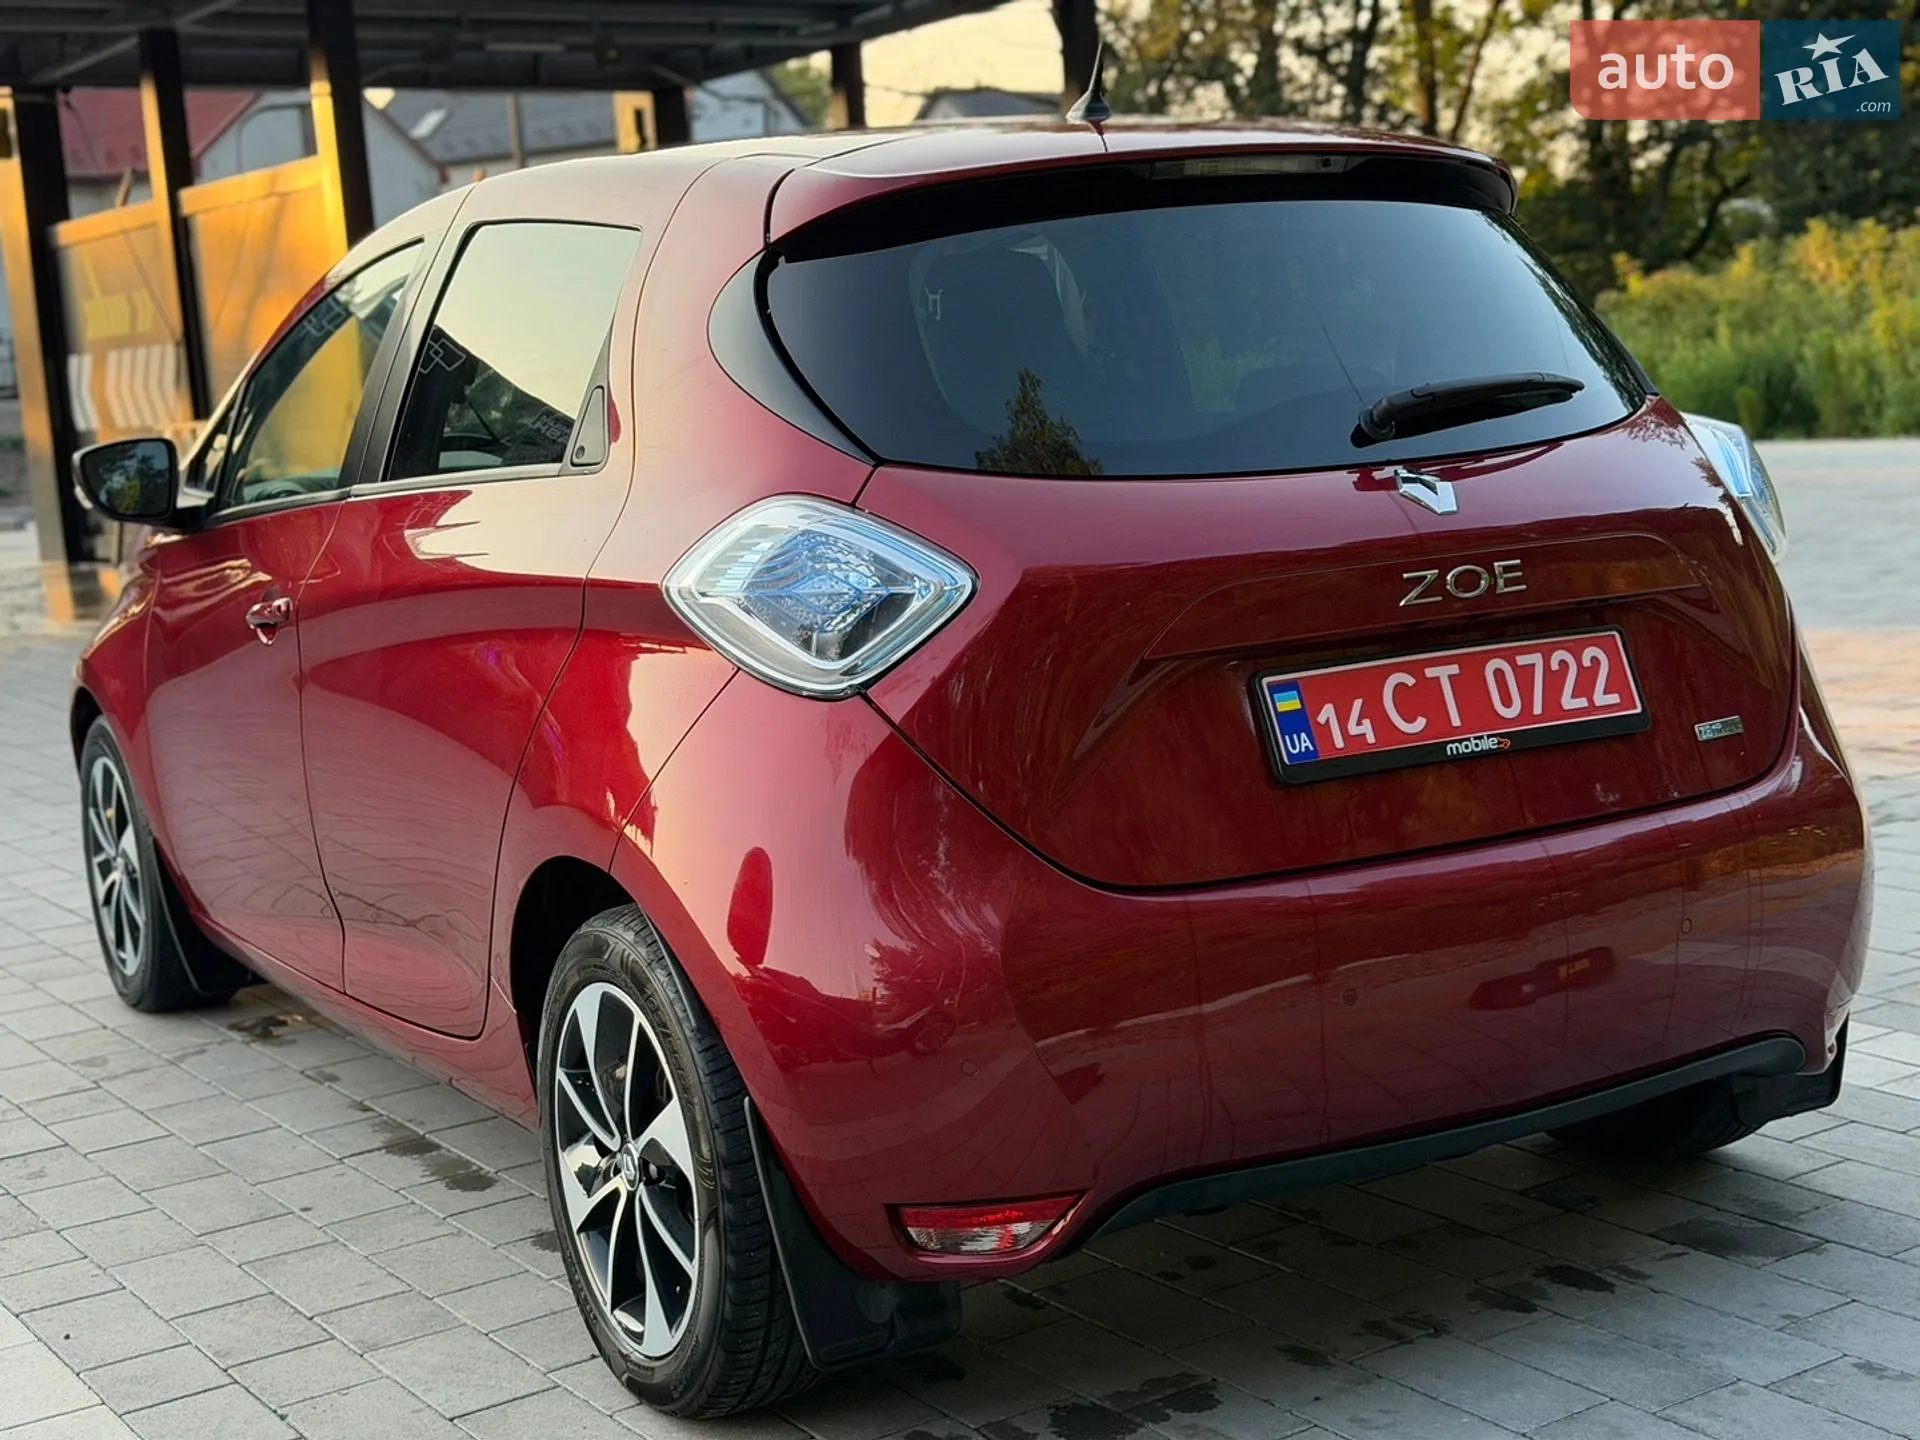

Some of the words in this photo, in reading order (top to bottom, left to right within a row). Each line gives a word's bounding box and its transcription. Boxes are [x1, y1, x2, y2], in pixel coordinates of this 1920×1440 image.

[1399, 558, 1527, 607] ZOE
[1316, 697, 1377, 750] 14
[1383, 664, 1464, 735] CT
[1484, 646, 1621, 720] 0722
[1285, 732, 1315, 755] UA
